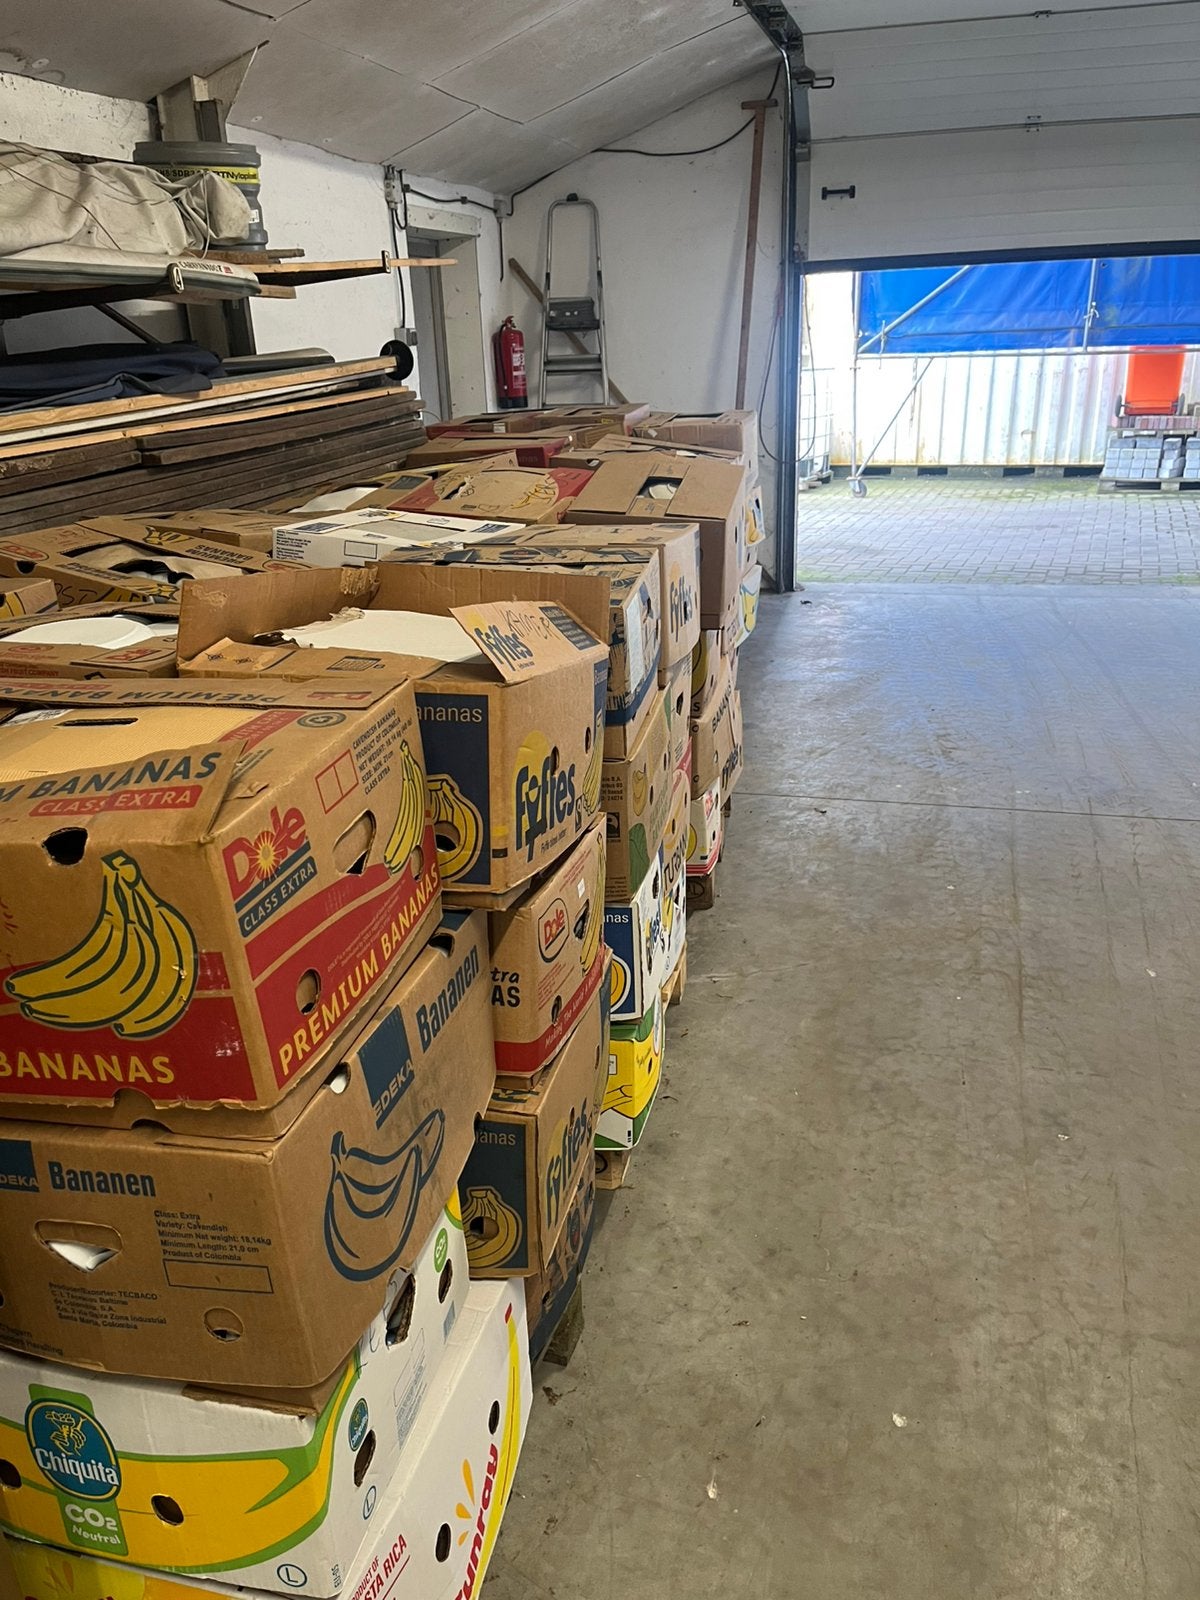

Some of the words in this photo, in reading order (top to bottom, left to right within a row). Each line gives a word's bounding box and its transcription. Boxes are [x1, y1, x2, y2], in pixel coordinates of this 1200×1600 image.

[194, 543, 254, 561] BANANAS
[355, 738, 376, 761] PRODUCT
[28, 752, 222, 799] BANANAS
[364, 778, 378, 795] CLASS
[378, 765, 391, 781] EXTRA
[115, 790, 194, 807] EXTRA
[222, 804, 308, 901] Dole
[243, 894, 280, 933] CLASS
[279, 864, 315, 900] EXTRA
[544, 907, 566, 946] Dole
[278, 948, 382, 1077] PREMIUM
[380, 861, 440, 961] BANANAS
[415, 943, 480, 1054] Bananen
[491, 984, 521, 1008] AS
[0, 1051, 175, 1084] BANANAS
[373, 1057, 414, 1118] EDEKA
[48, 1159, 157, 1198] Bananen
[154, 1209, 179, 1219] Class:
[179, 1211, 201, 1220] Extra
[155, 1220, 186, 1230] Variety:
[186, 1221, 228, 1232] Cavendish
[158, 1229, 194, 1240] Minimum
[194, 1232, 209, 1240] Net
[211, 1234, 239, 1243] weight:
[160, 1239, 196, 1249] Minimum
[197, 1241, 227, 1252] Length:
[162, 1248, 194, 1259] Product
[194, 1250, 203, 1259] of
[203, 1252, 242, 1261] Colombia
[34, 1448, 119, 1486] Chiquita
[64, 1503, 118, 1532] CO2
[455, 1443, 499, 1600] unray
[72, 1525, 121, 1545] Neutral
[370, 1555, 380, 1573] OF
[382, 1533, 408, 1579] RICA
